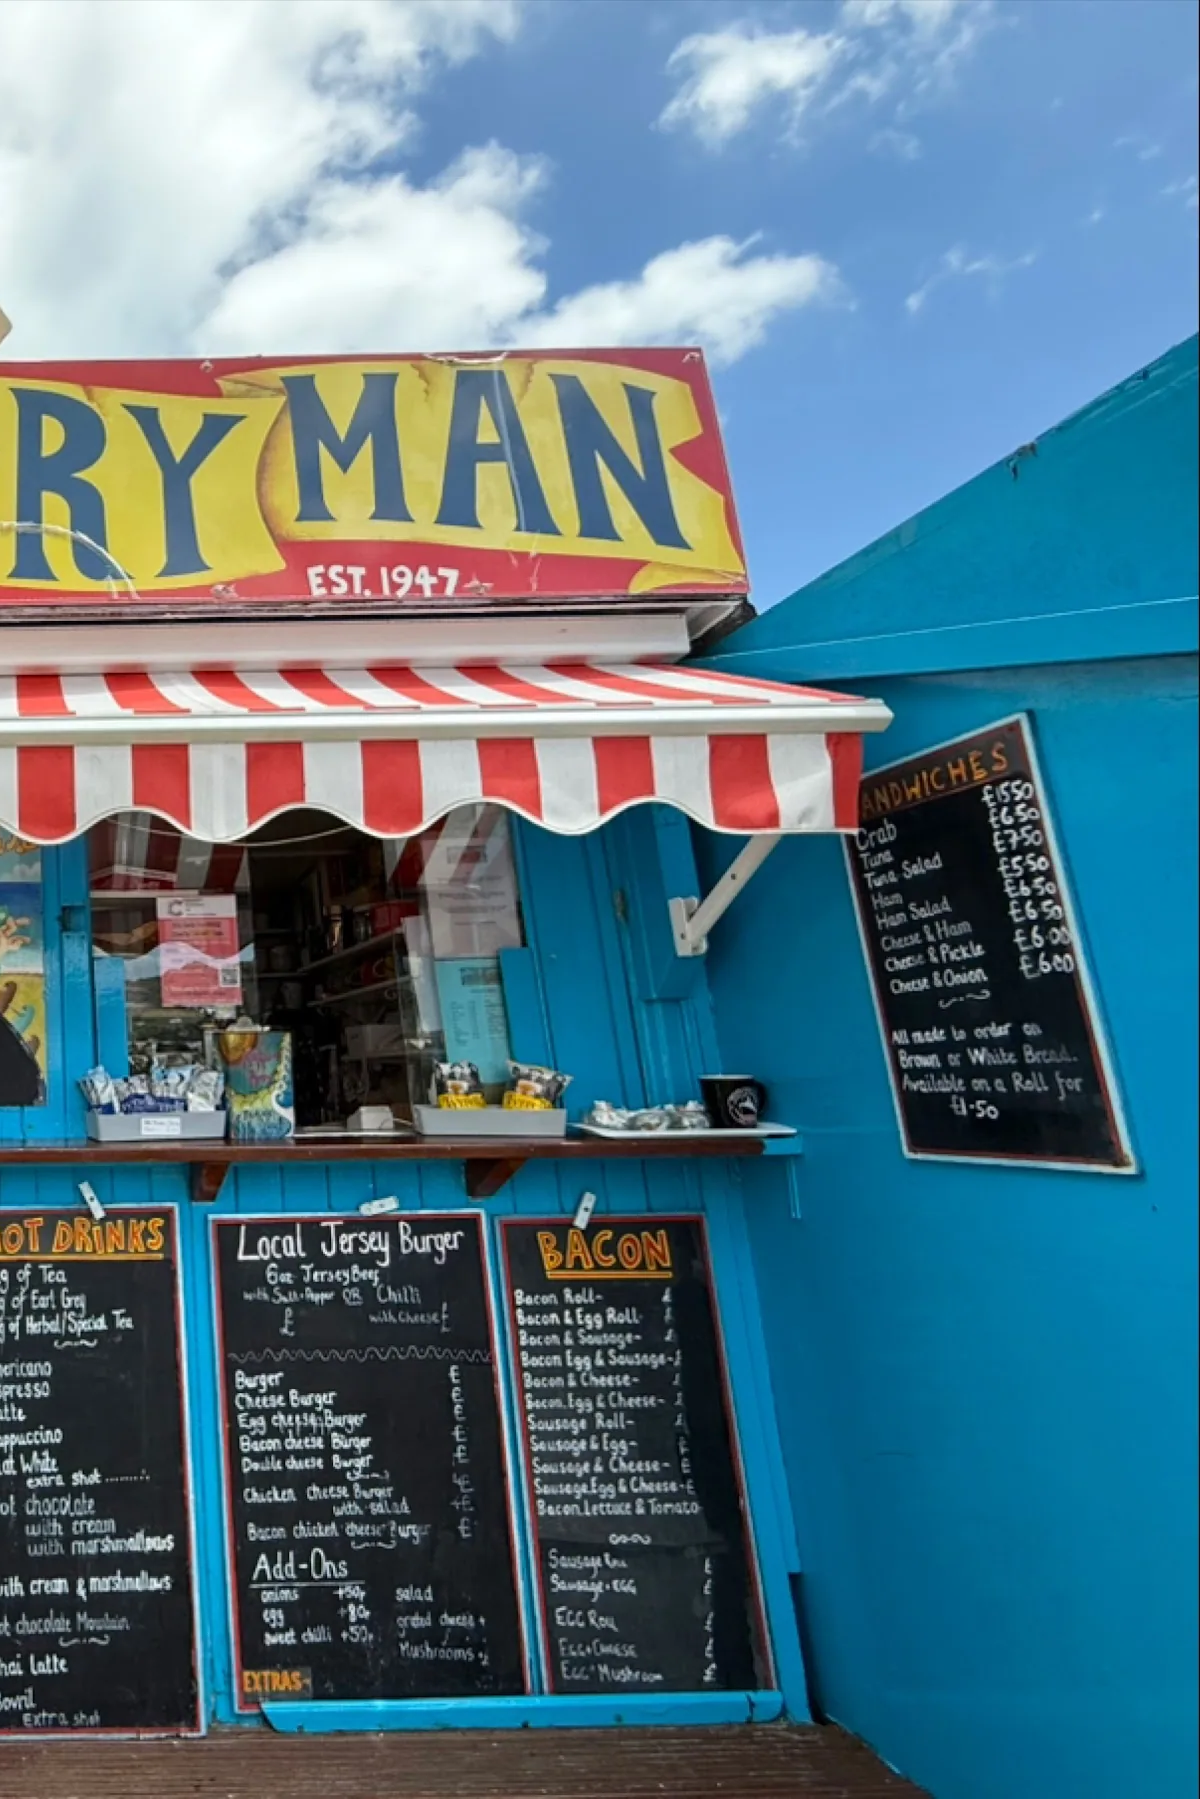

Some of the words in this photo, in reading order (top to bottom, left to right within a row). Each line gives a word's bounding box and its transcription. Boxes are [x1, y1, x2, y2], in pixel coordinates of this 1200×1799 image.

[280, 369, 693, 552] MAN
[307, 566, 371, 598] EST.
[381, 566, 460, 598] 1947
[861, 742, 1009, 818] ANDWICHES
[855, 819, 898, 851] Crab
[860, 850, 894, 871] Tuna
[864, 868, 898, 890] Tuna
[902, 852, 943, 879] Salad
[871, 891, 904, 910] Ham
[875, 910, 908, 930] Ham
[910, 897, 953, 923] Salad
[881, 929, 923, 951] Cheese
[937, 918, 972, 939] Ham
[885, 954, 925, 972] Cheese
[940, 940, 985, 964] Pickle
[890, 975, 930, 995] Cheese
[943, 966, 988, 986] Onion
[892, 1030, 910, 1046] All
[912, 1026, 947, 1043] made
[952, 1025, 967, 1041] to
[974, 1021, 1013, 1039] order
[1023, 1023, 1042, 1036] on
[898, 1049, 941, 1069] Brown
[948, 1054, 961, 1067] or
[967, 1047, 1018, 1066] White
[902, 1074, 966, 1093] Available
[972, 1078, 988, 1091] on
[995, 1078, 1007, 1093] a
[1012, 1073, 1049, 1093] Roll
[1055, 1070, 1083, 1101] for
[237, 1223, 307, 1261] Local
[320, 1221, 390, 1267] Jersey
[398, 1221, 465, 1265] Burger
[537, 1228, 671, 1271] BACON
[16, 1263, 32, 1289] of
[38, 1264, 67, 1284] Tea
[301, 1263, 349, 1287] Jersey
[11, 1289, 26, 1318] of
[31, 1289, 55, 1310] Earl
[61, 1288, 87, 1316] Grey
[376, 1285, 422, 1305] Chilli
[514, 1289, 558, 1306] Bacon
[8, 1316, 21, 1340] of
[112, 1308, 134, 1329] Tea
[369, 1309, 397, 1324] with
[516, 1308, 560, 1326] Bacon
[575, 1308, 604, 1329] Egg
[519, 1331, 560, 1346] Bacon
[520, 1351, 562, 1367] Bacon
[565, 1350, 592, 1371] Egg
[234, 1370, 284, 1393] Burger
[523, 1371, 564, 1388] Bacon
[234, 1393, 286, 1410] Cheese
[288, 1388, 337, 1411] Burger
[237, 1413, 266, 1435] Egg
[324, 1409, 367, 1433] Burger
[527, 1413, 587, 1435] Sausage
[239, 1435, 281, 1452] Bacon
[330, 1432, 372, 1454] Burger
[530, 1435, 587, 1456] Sausage
[20, 1450, 58, 1474] White
[241, 1455, 282, 1473] Double
[332, 1454, 373, 1475] Burger
[532, 1457, 590, 1477] Sausage
[26, 1473, 65, 1489] extra
[25, 1492, 95, 1517] chocolate
[243, 1486, 297, 1504] Chicken
[352, 1482, 393, 1501] Burger
[333, 1502, 363, 1516] with
[369, 1497, 411, 1515] salad
[25, 1517, 63, 1537] with
[72, 1518, 116, 1535] cream
[247, 1522, 287, 1541] Bacon
[292, 1520, 339, 1538] chicken
[27, 1538, 64, 1557] with
[71, 1528, 174, 1555] marshmallows
[252, 1547, 349, 1581] Add-Ons
[29, 1577, 69, 1595] cream
[261, 1587, 299, 1602] onions
[395, 1584, 433, 1602] salad
[550, 1574, 604, 1602] Sausage
[16, 1608, 72, 1635] chocolate
[263, 1608, 284, 1628] egg
[301, 1625, 331, 1643] chilli
[399, 1640, 475, 1661] Mushrooms
